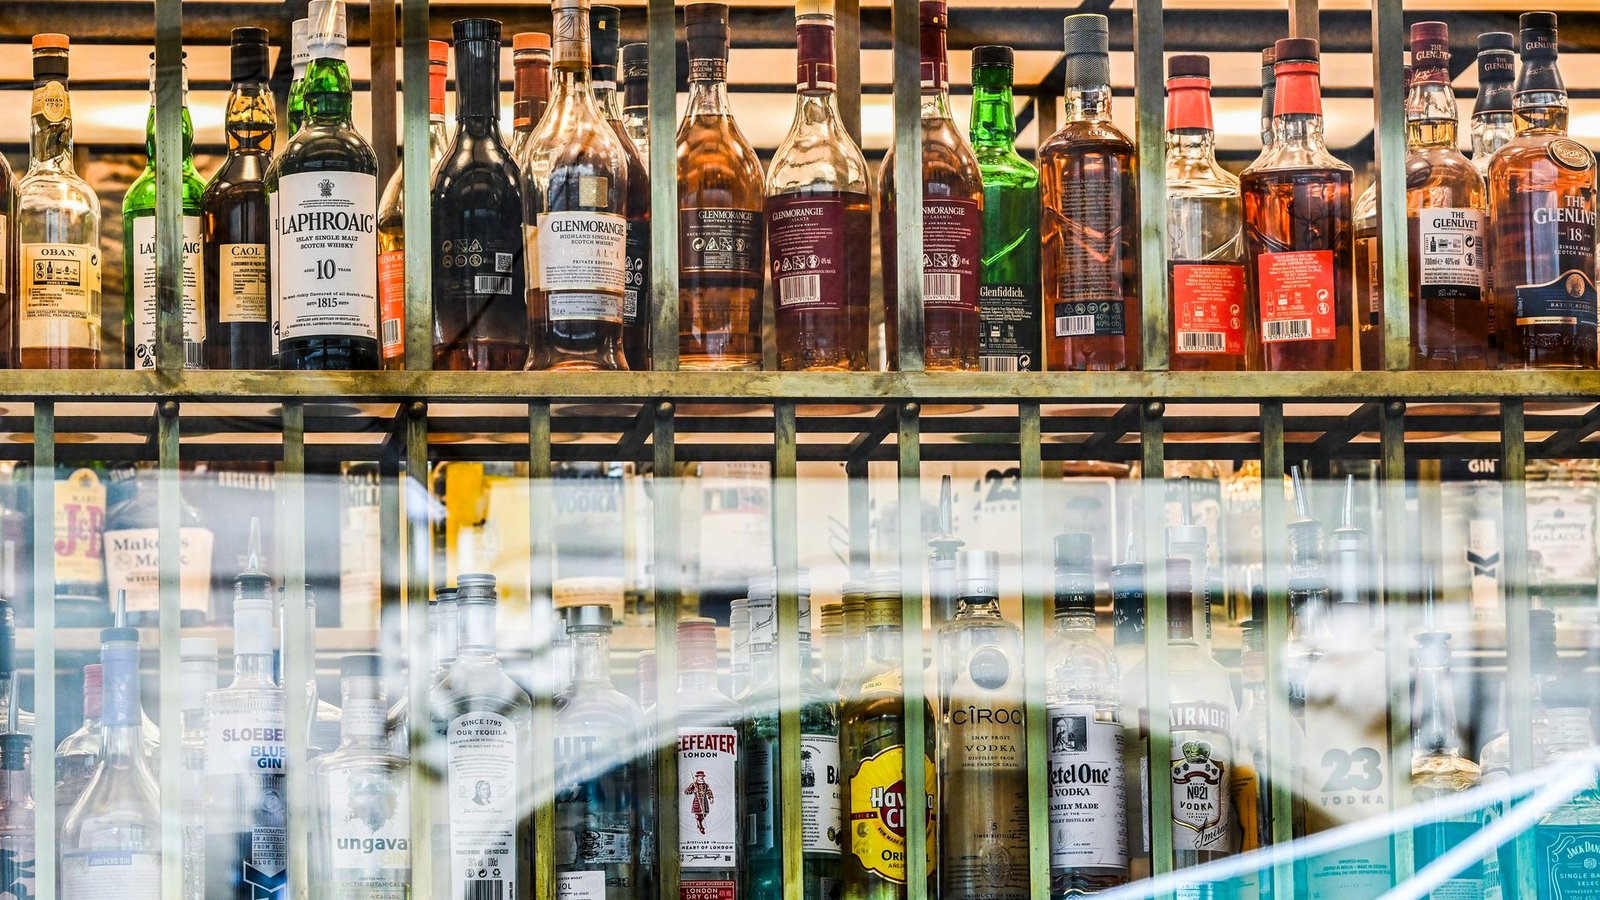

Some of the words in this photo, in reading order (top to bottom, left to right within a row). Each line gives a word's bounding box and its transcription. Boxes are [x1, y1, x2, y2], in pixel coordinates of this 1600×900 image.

[1564, 195, 1585, 208] THE
[698, 210, 753, 221] GLENMORANGIE
[773, 207, 824, 221] GLENMORANGIE
[922, 206, 965, 216] NMORANGIE
[1451, 211, 1465, 219] THE
[282, 211, 373, 236] LAPHROAIG
[551, 220, 624, 237] GLENMORANGIE
[1432, 218, 1478, 230] GLENLIVET
[296, 235, 314, 243] ISLAY
[1569, 228, 1583, 241] 18
[231, 245, 261, 256] CAOL
[300, 242, 325, 250] SCOTCH
[41, 248, 76, 257] OBAN
[316, 258, 336, 280] 10
[980, 286, 1025, 298] Glenfiddich.
[317, 297, 338, 308] 1815
[1468, 459, 1496, 473] GIN
[557, 492, 618, 514] VODKA
[461, 719, 484, 728] SINCE
[486, 719, 502, 727] 1795
[222, 728, 286, 742] SLOEBE
[965, 744, 1016, 752] VODKA
[257, 757, 282, 769] GIN
[1050, 764, 1077, 785] etel
[1078, 763, 1110, 784] One
[1321, 747, 1384, 793] 23
[1055, 787, 1091, 797] VODKA
[1074, 802, 1099, 810] MADE
[1180, 801, 1214, 811] VODKA
[1321, 794, 1384, 807] VODKA
[992, 822, 998, 830] 5
[337, 838, 408, 854] ungava
[1567, 845, 1585, 859] JACK
